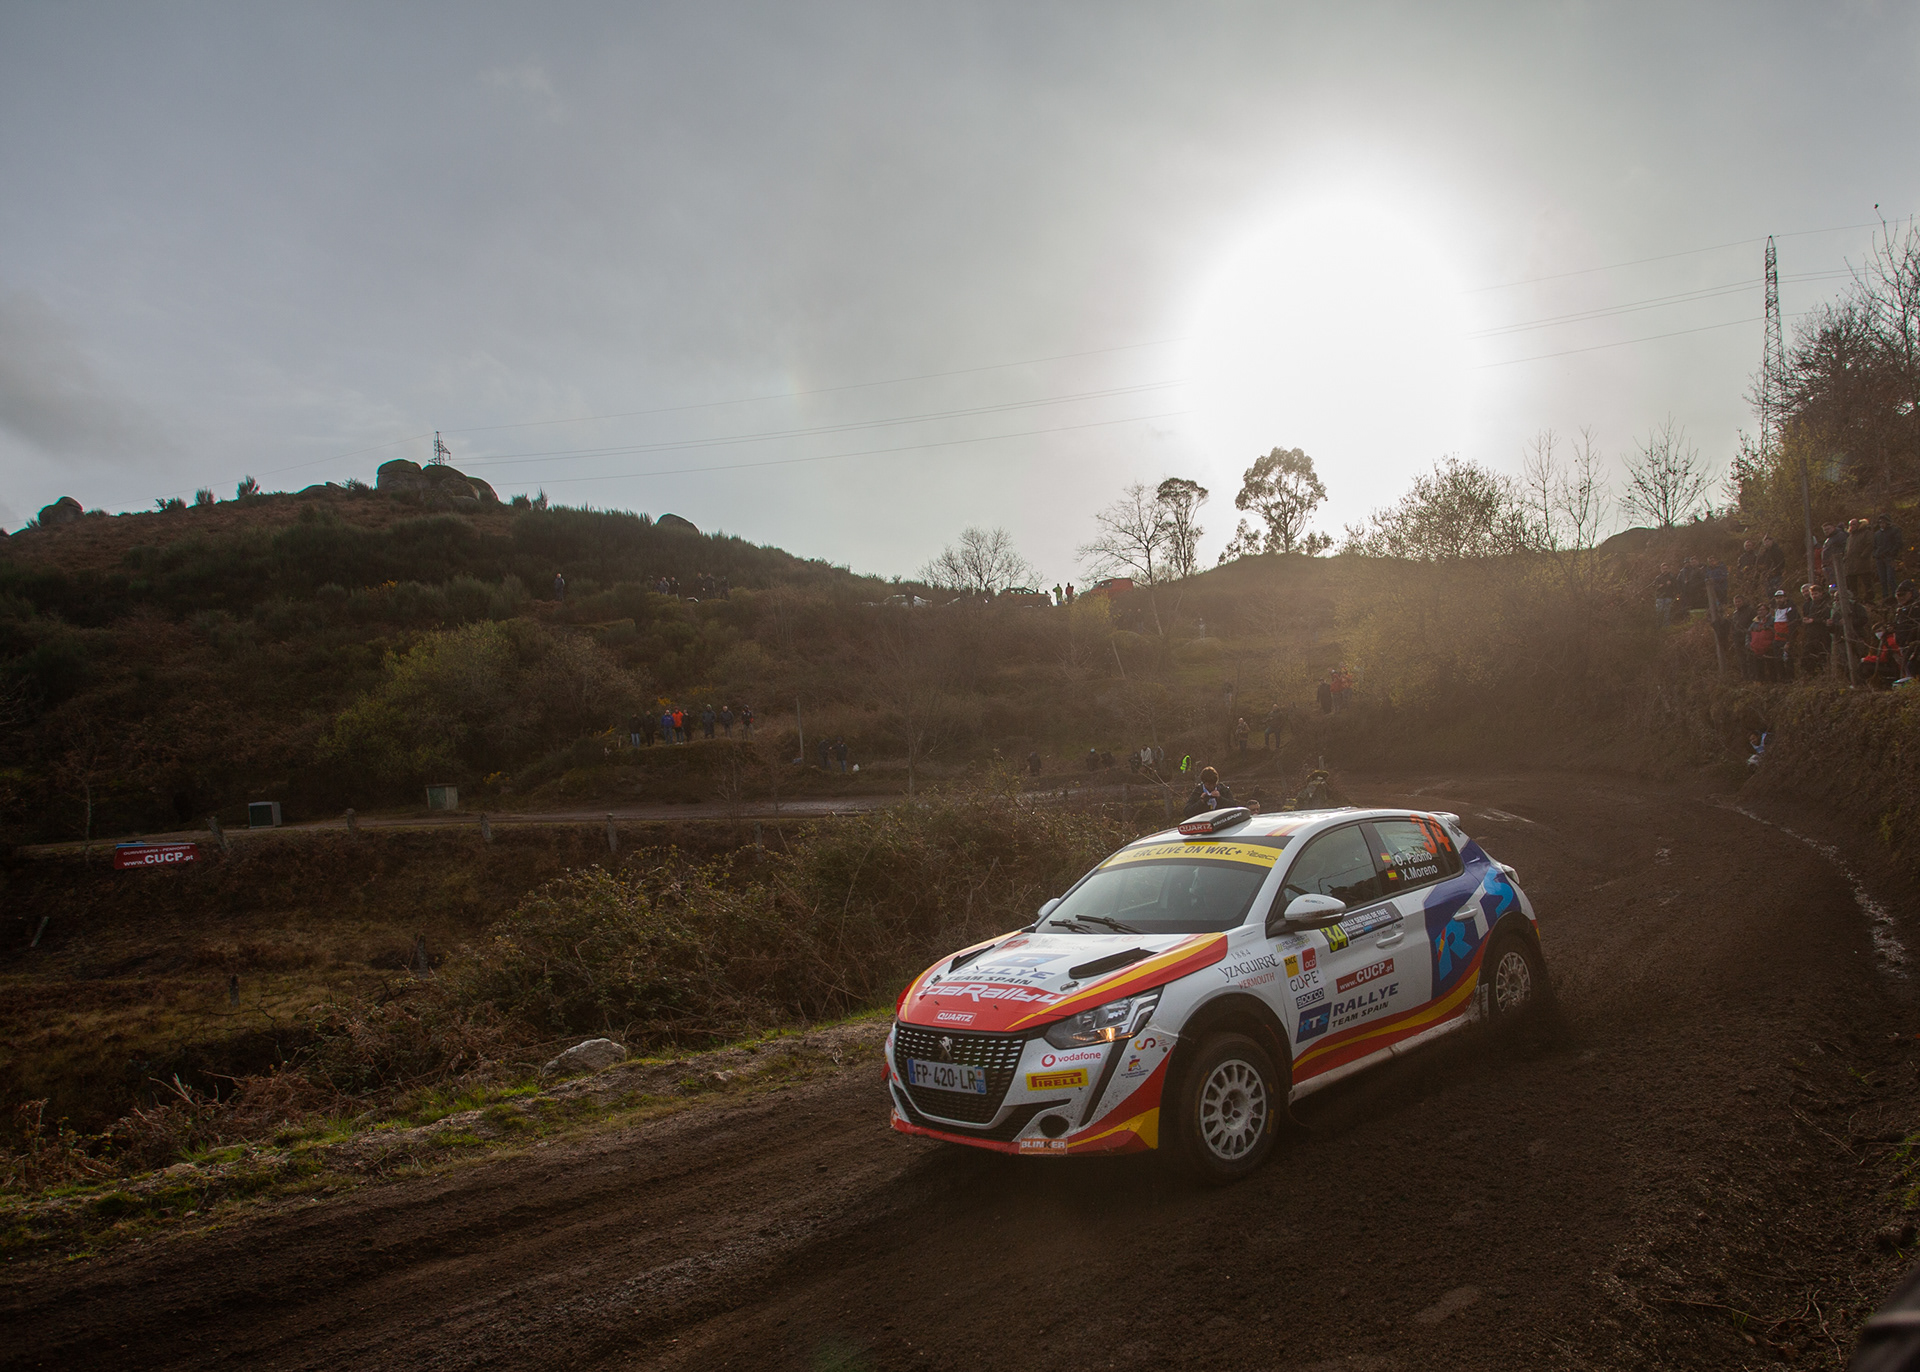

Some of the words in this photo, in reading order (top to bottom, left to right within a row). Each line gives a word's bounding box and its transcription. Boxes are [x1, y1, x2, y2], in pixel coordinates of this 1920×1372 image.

[1179, 822, 1213, 834] QUARTZ
[1410, 814, 1452, 854] 34
[1133, 849, 1152, 858] ERC
[1156, 845, 1183, 856] LIVE
[1186, 844, 1202, 854] ON
[1205, 846, 1242, 856] WRC+
[1393, 854, 1407, 866] O.
[1406, 851, 1433, 864] Palomo
[123, 852, 194, 867] www.CUCP.pt
[1400, 864, 1438, 880] X.Moreno
[1320, 924, 1348, 952] 34
[1230, 948, 1252, 960] 1884
[1218, 953, 1281, 983] YZAGUIRRE
[1339, 962, 1393, 990] www.CUCP.pt
[984, 975, 1033, 986] SPAIN
[1238, 971, 1276, 990] VERMOUTH
[1297, 988, 1324, 1006] sparco
[1333, 983, 1399, 1017] RALLYE
[937, 1012, 974, 1023] QUARTZ
[1331, 1013, 1358, 1027] TEAM
[1361, 1001, 1389, 1017] SPAIN
[1299, 1012, 1329, 1033] RTS
[1058, 1051, 1102, 1063] vodafone
[1031, 1071, 1083, 1088] PIRELLI
[1021, 1140, 1066, 1149] BLINKER
